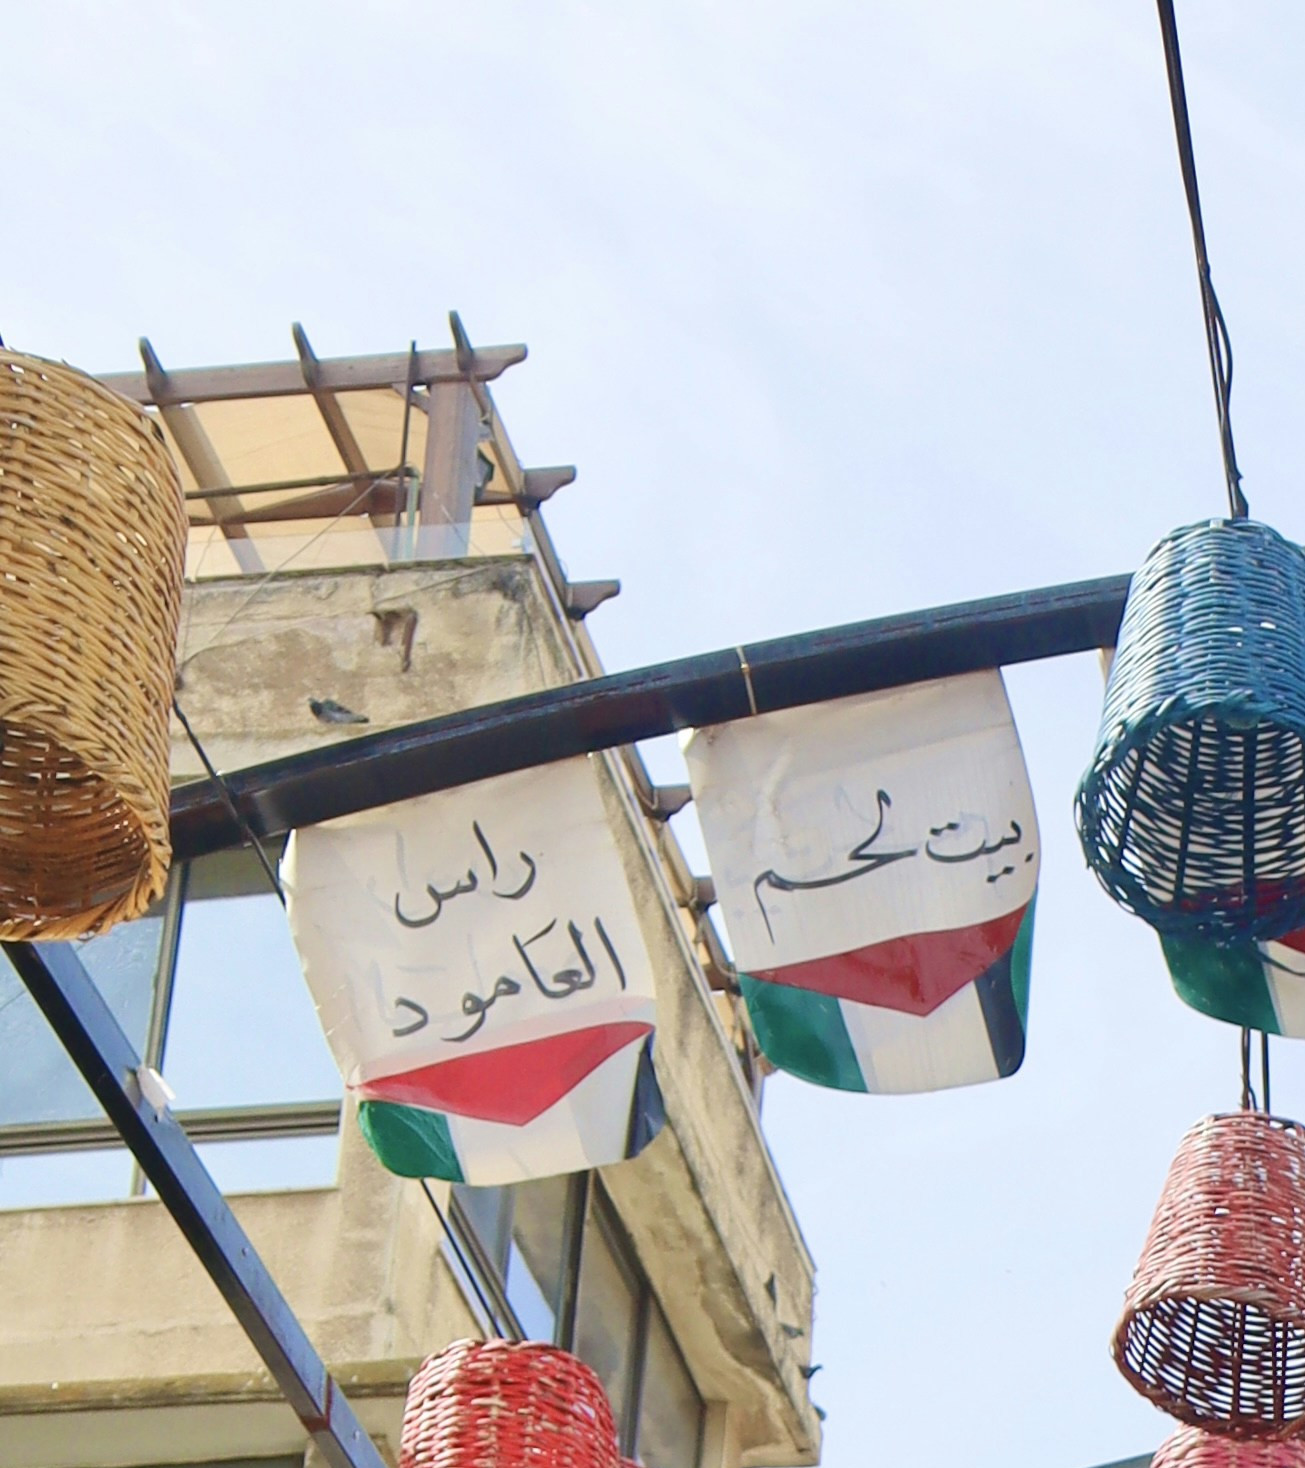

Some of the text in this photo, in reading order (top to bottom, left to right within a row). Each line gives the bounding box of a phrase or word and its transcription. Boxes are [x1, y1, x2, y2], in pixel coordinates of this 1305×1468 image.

[394, 820, 539, 930] راس
[753, 788, 1036, 945] بيت لحم
